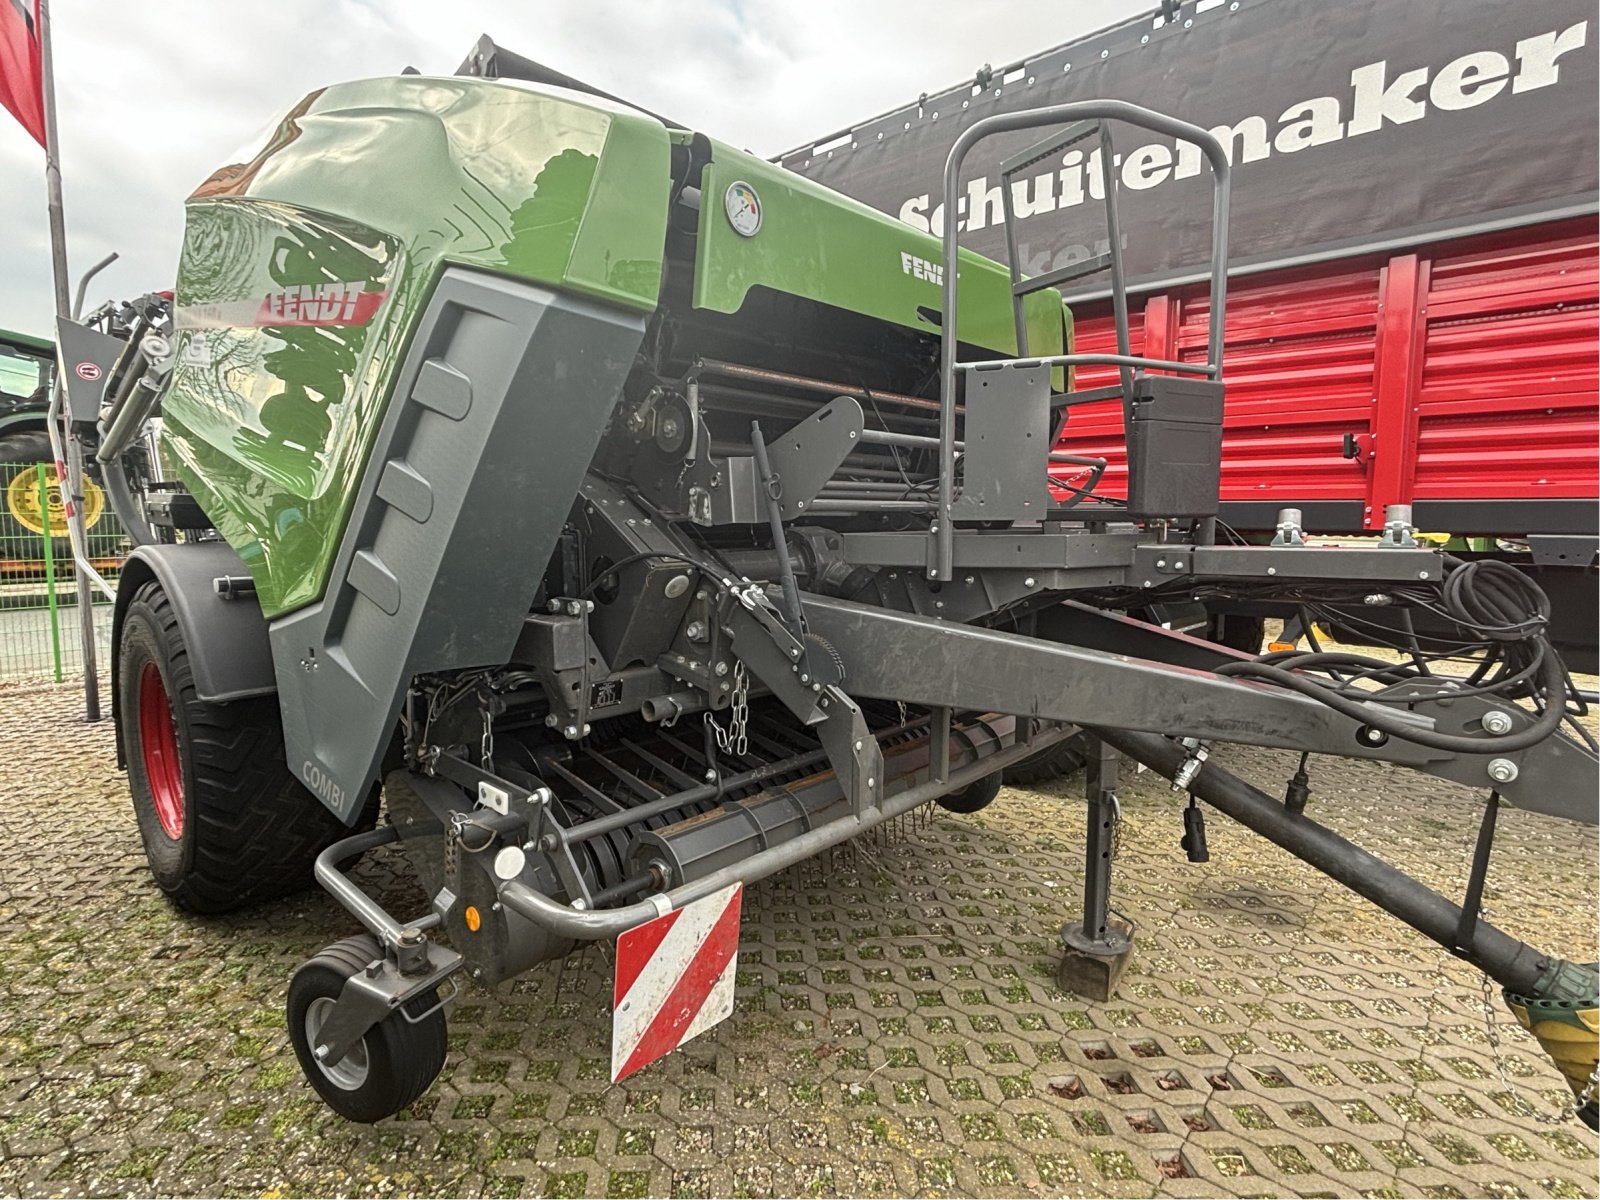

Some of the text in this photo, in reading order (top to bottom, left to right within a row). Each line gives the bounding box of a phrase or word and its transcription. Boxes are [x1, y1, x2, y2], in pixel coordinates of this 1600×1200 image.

[899, 20, 1588, 238] Schuitemaker
[269, 280, 367, 321] FENDT
[302, 760, 345, 813] COMBI
